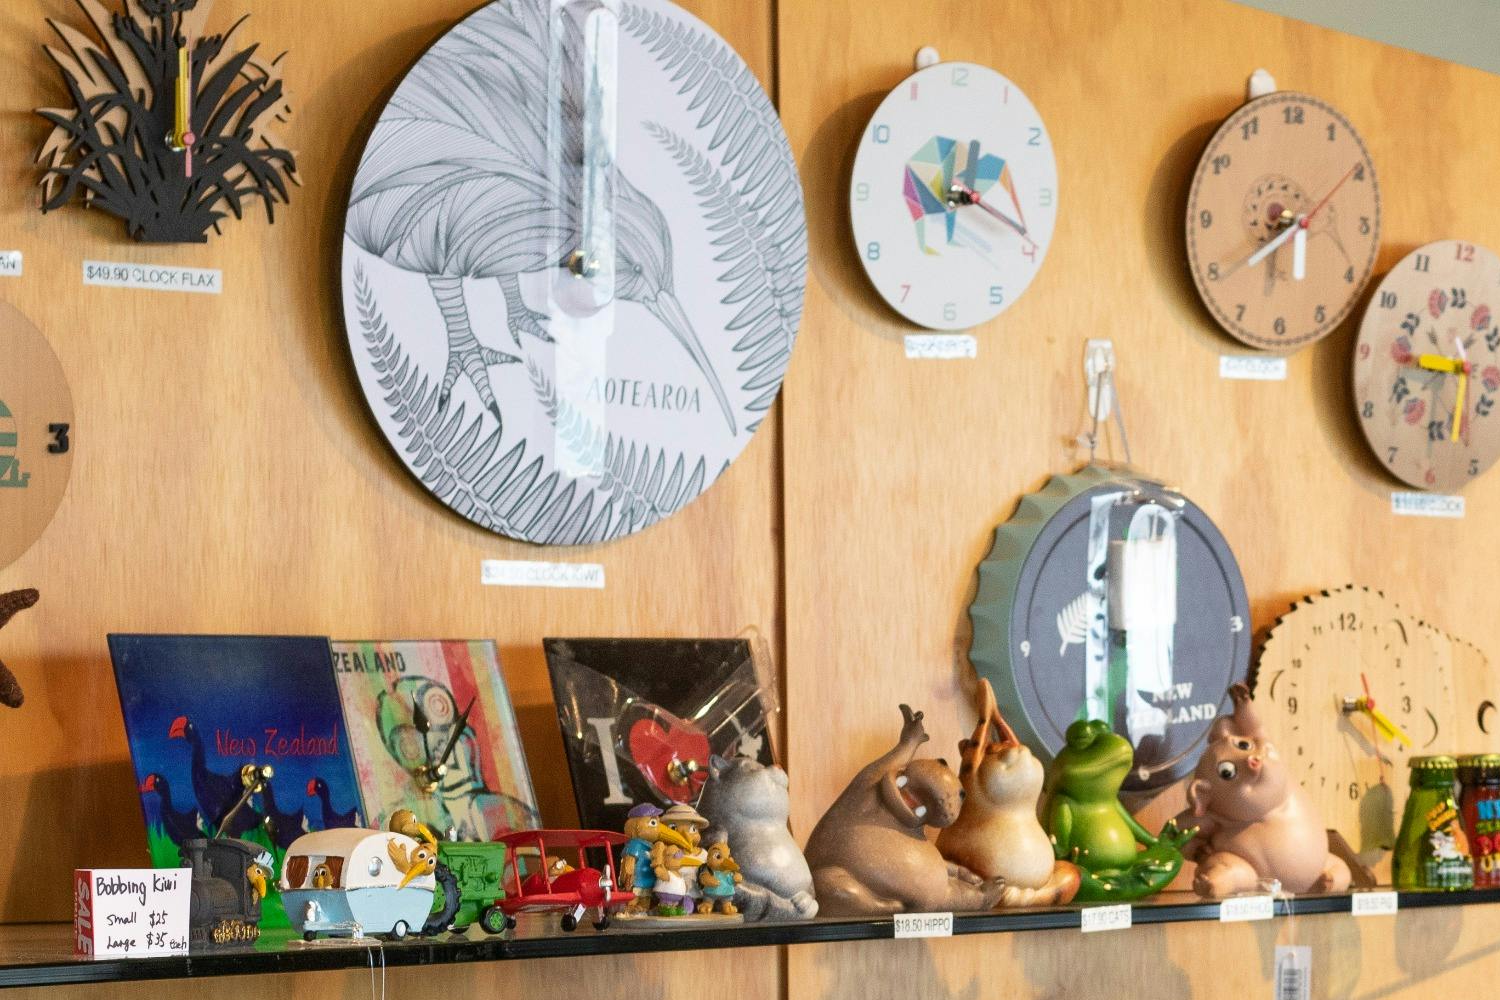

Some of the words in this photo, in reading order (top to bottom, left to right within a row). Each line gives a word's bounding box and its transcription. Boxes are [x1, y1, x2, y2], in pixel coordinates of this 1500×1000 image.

[951, 68, 968, 86] 12
[1283, 106, 1304, 125] 12
[872, 124, 890, 144] 10
[1028, 127, 1041, 147] 2
[1241, 117, 1259, 140] 11
[1327, 123, 1335, 141] 1
[1211, 154, 1231, 175] 10
[1353, 163, 1365, 181] 2
[856, 182, 869, 201] 9
[1040, 188, 1051, 207] 3
[1200, 211, 1212, 229] 9
[1359, 216, 1369, 235] 3
[867, 241, 880, 261] 8
[1022, 245, 1039, 263] 4
[1456, 244, 1475, 262] 12
[1207, 263, 1219, 281] 8
[1414, 254, 1430, 273] 11
[86, 266, 128, 281] $49.90
[132, 270, 177, 284] CLOCK
[182, 272, 214, 287] FLAX
[1345, 266, 1354, 283] 4
[901, 285, 911, 304] 7
[990, 286, 1003, 305] 5
[1380, 291, 1397, 309] 10
[944, 303, 956, 322] 6
[1236, 304, 1246, 322] 7
[1315, 305, 1325, 323] 5
[1273, 317, 1285, 335] 6
[1360, 343, 1370, 360] 9
[588, 376, 702, 413] AOTEAROA
[1363, 401, 1373, 418] 8
[47, 423, 70, 454] 3
[1387, 447, 1398, 464] 7
[1425, 468, 1435, 485] 6
[1469, 459, 1479, 476] 5
[1230, 616, 1243, 632] 3
[1339, 612, 1357, 632] 12
[1020, 641, 1031, 657] 9
[333, 651, 407, 673] ZEALAND
[1289, 698, 1297, 714] 9
[1402, 696, 1411, 713] 3
[215, 728, 256, 756] New
[264, 721, 340, 757] Zealand
[586, 717, 633, 805] I
[1349, 784, 1358, 800] 6
[96, 875, 147, 906] Bobbing
[153, 873, 178, 893] Kiwi
[78, 877, 93, 957] SALE
[149, 910, 168, 928] $25
[895, 920, 922, 933] $18.50
[924, 919, 950, 932] HIPPO
[106, 935, 136, 951] Large
[146, 931, 168, 949] $35
